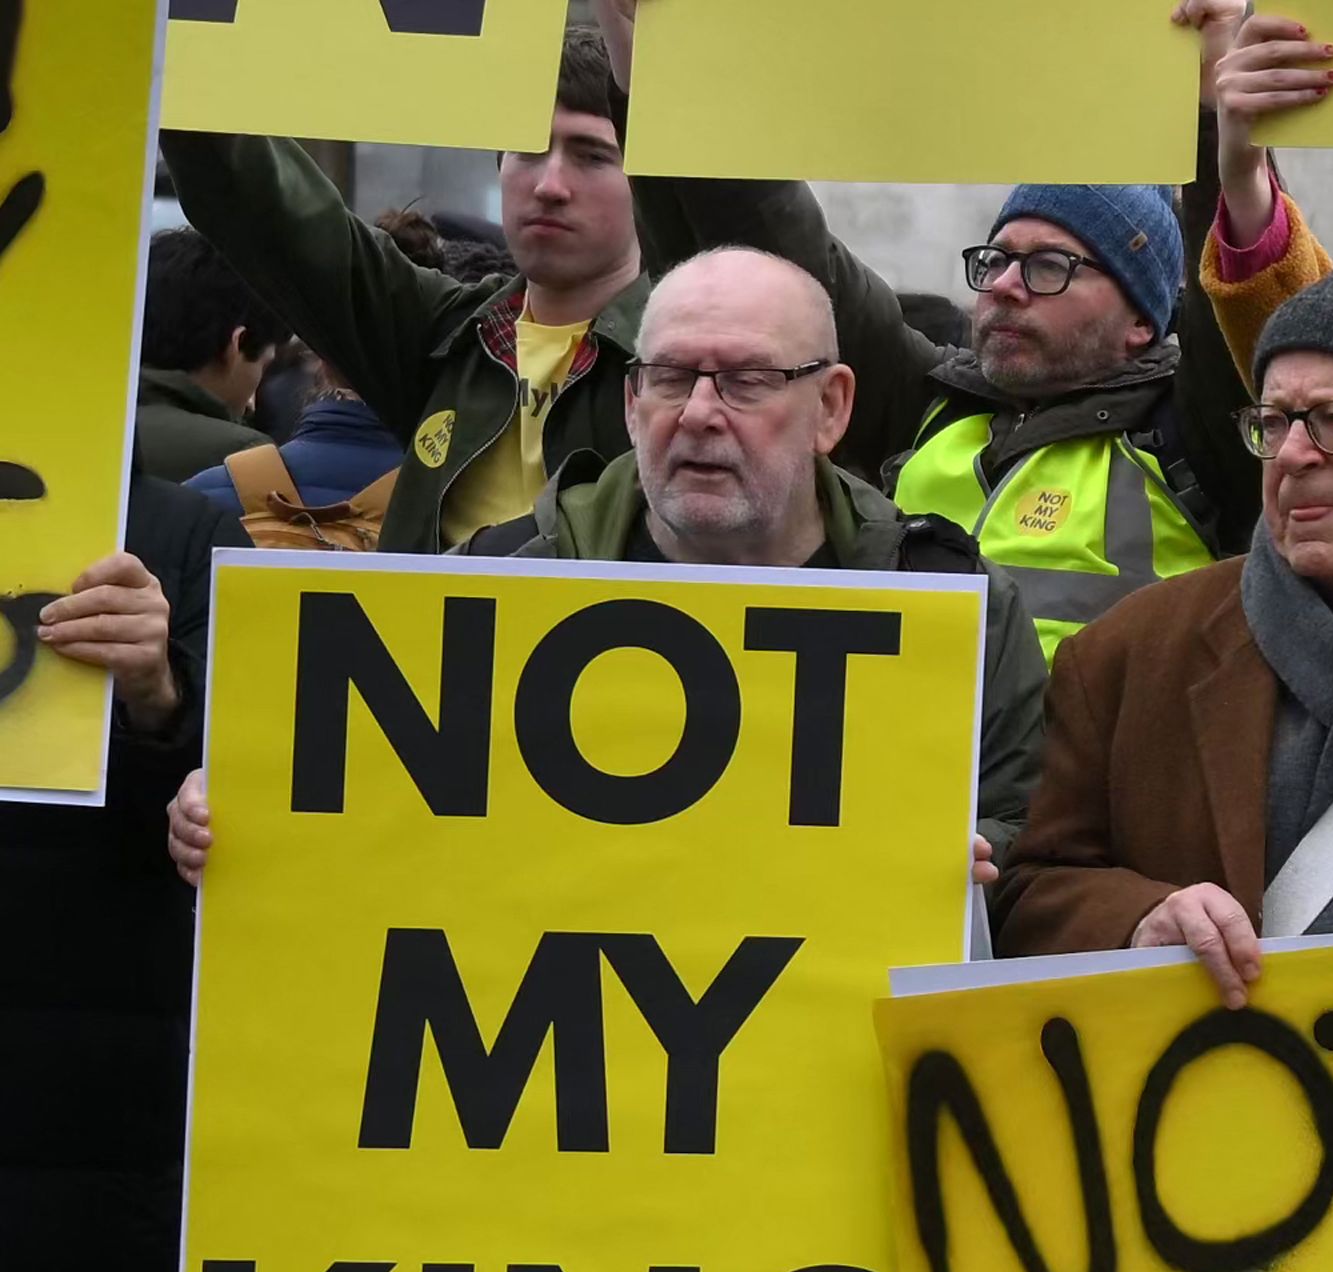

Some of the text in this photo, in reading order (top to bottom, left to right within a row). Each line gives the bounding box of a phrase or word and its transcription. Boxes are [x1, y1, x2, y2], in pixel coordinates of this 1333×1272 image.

[434, 428, 448, 446] MY
[418, 433, 442, 463] KING
[1038, 491, 1068, 506] NOT
[1033, 504, 1059, 517] MY
[1019, 514, 1056, 531] KING
[290, 590, 902, 827] NOT
[357, 927, 807, 1156] MY
